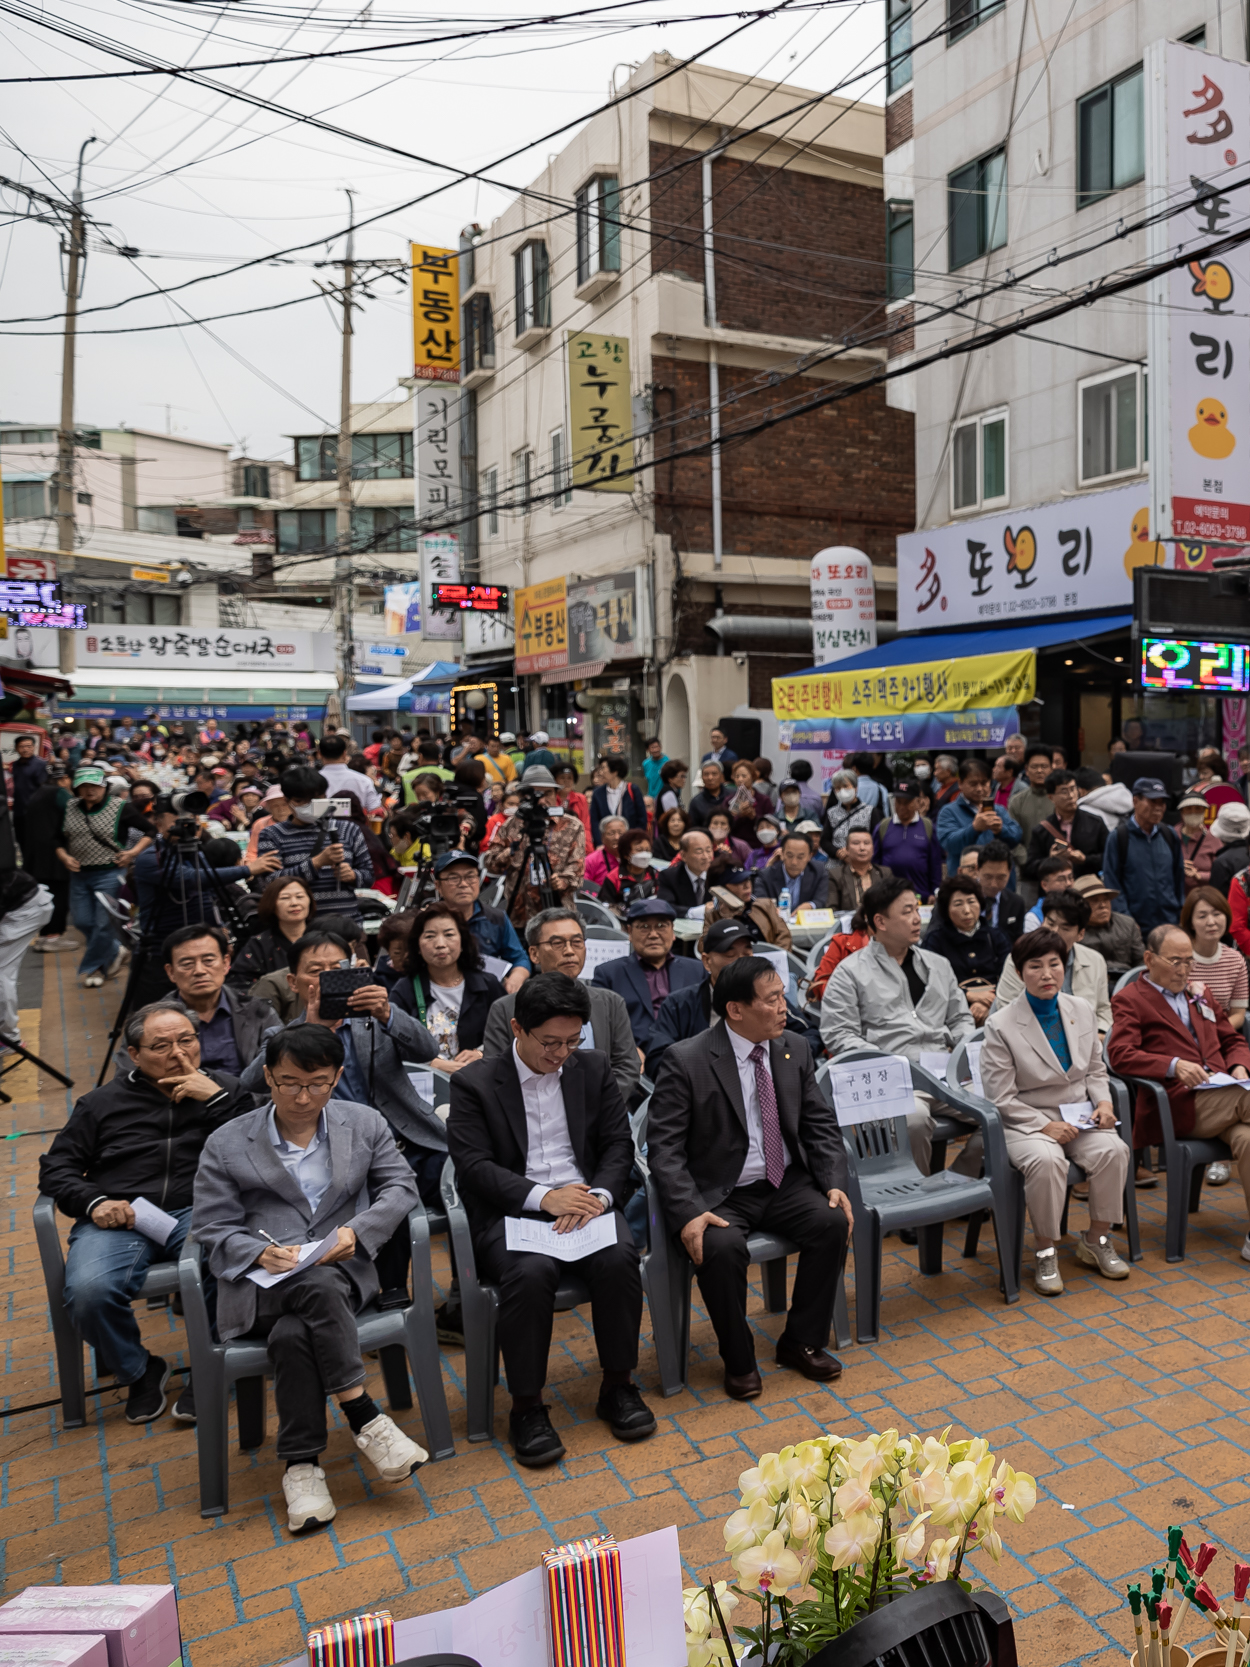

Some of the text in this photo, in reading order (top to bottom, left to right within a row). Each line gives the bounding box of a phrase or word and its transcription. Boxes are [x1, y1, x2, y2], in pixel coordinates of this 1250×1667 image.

[418, 250, 455, 363] 부동산
[576, 340, 624, 363] 고향
[580, 364, 621, 477] 누룽지
[427, 397, 453, 512] 기린모피
[1203, 478, 1223, 493] 본점
[1193, 504, 1230, 519] 예약문의
[1146, 642, 1246, 690] 오리
[846, 1069, 888, 1088] 구청장
